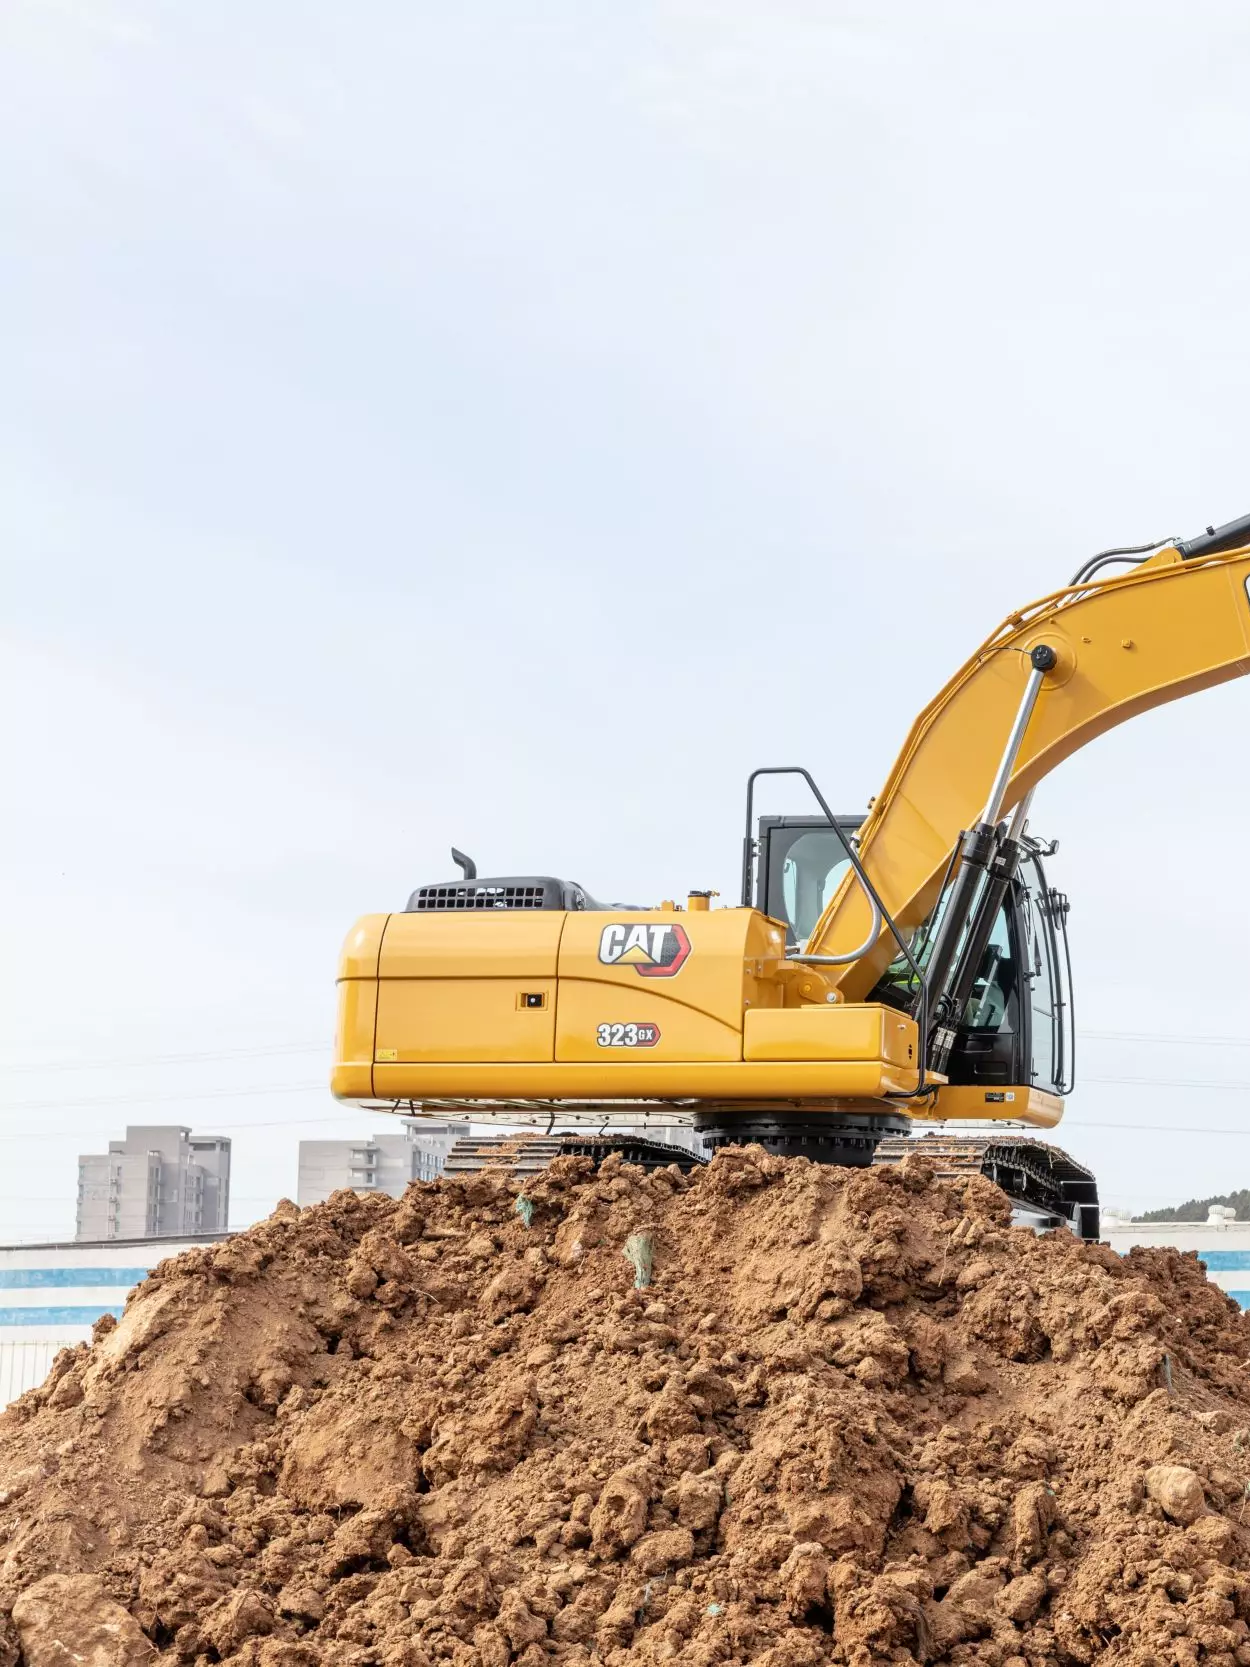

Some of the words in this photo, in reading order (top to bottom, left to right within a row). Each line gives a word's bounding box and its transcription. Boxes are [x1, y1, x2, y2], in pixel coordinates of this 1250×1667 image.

[600, 924, 673, 964] CAT
[597, 1023, 638, 1046] 323
[638, 1029, 653, 1041] GX
